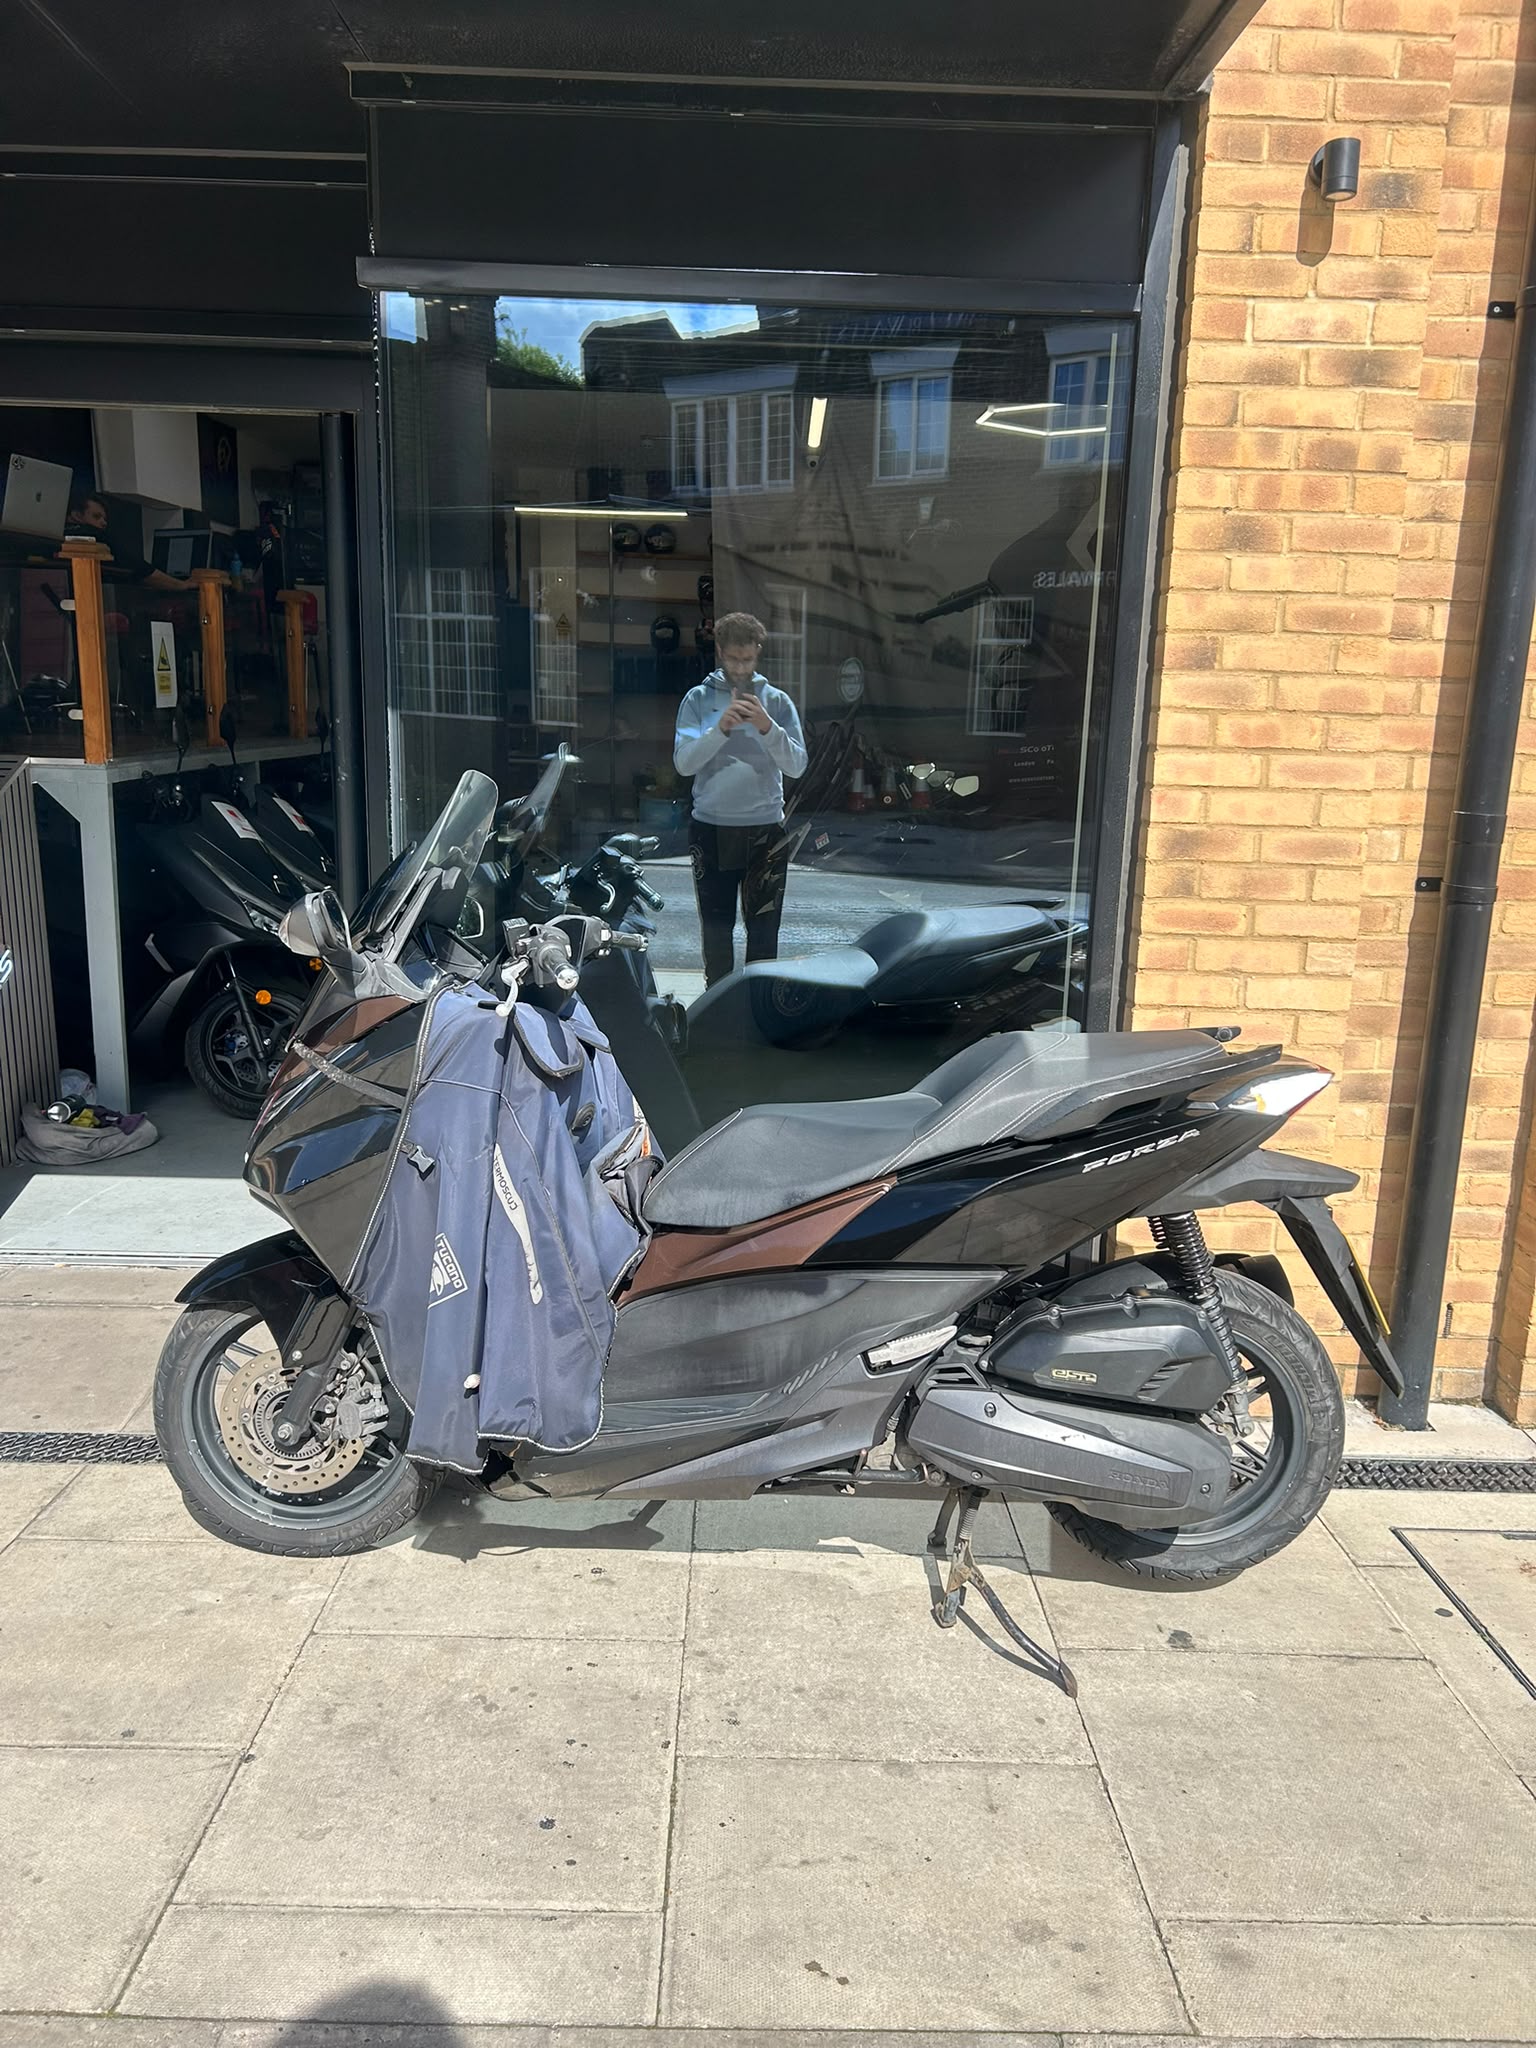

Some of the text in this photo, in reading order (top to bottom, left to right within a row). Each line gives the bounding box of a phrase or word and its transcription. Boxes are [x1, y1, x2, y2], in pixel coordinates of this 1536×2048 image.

[1081, 1128, 1201, 1174] FORZA
[437, 1239, 463, 1289] TUCANO
[1107, 1469, 1170, 1491] HONDA
